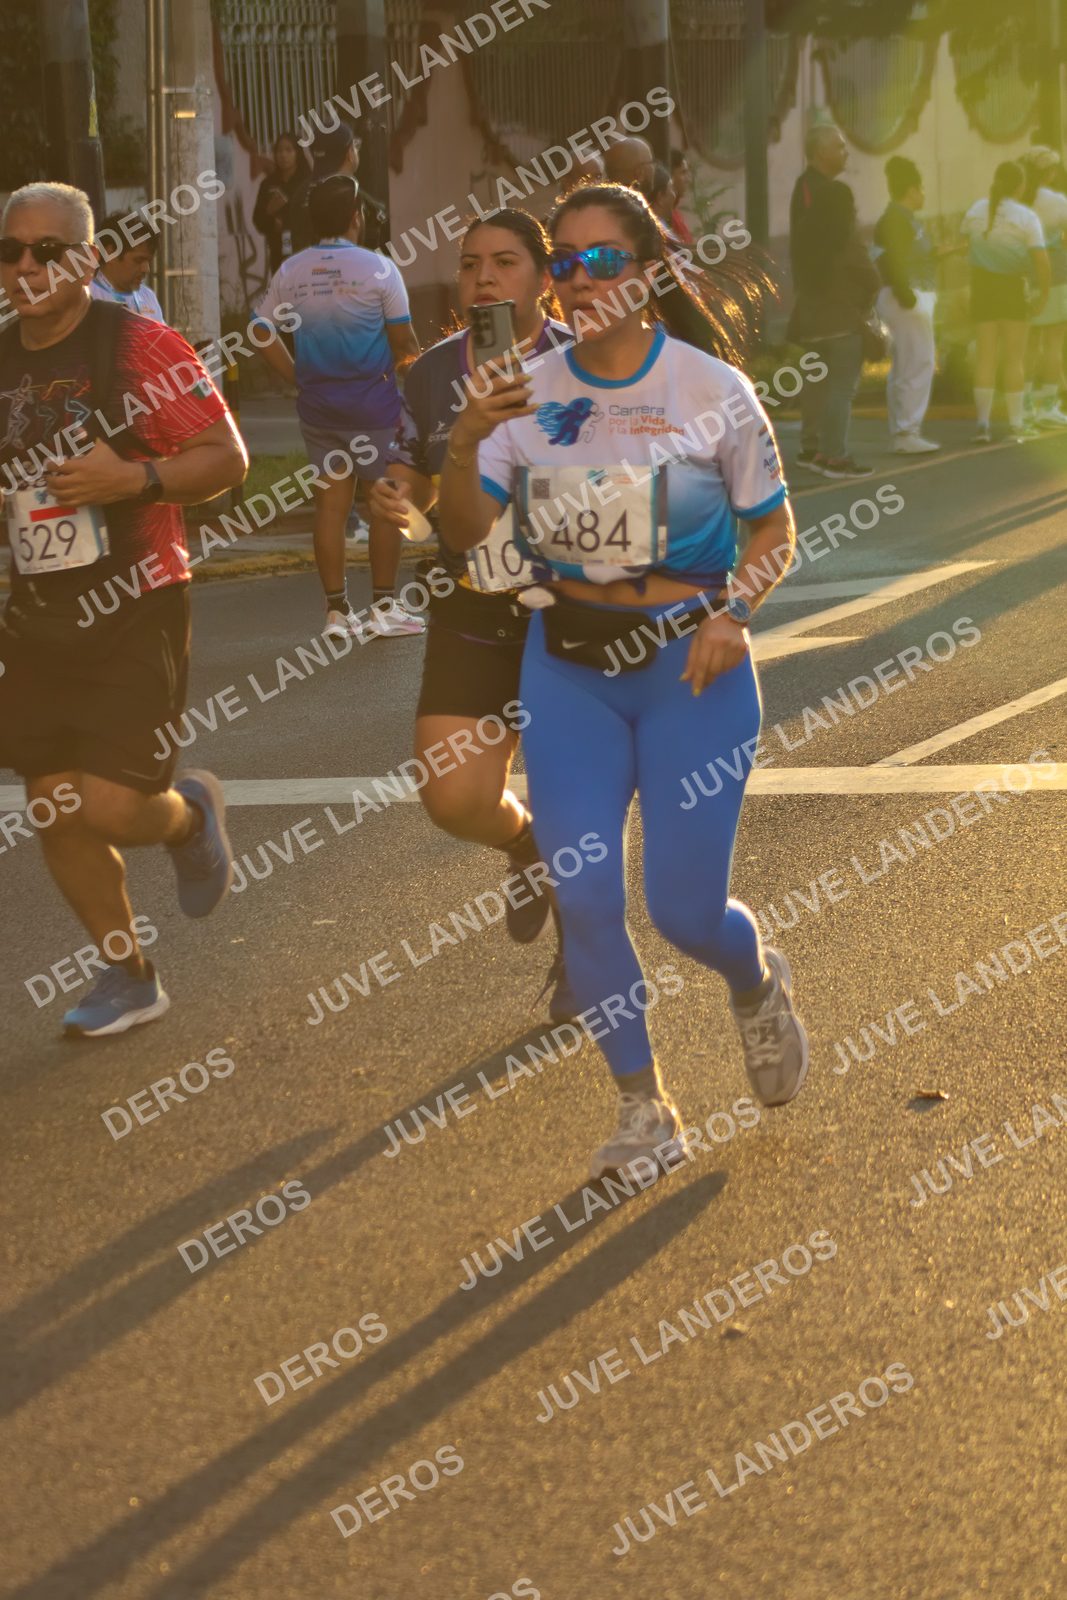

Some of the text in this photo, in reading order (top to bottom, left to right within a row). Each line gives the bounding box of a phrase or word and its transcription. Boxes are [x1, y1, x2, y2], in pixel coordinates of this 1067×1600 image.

[608, 405, 665, 416] Carrera
[640, 415, 665, 424] Vida
[18, 520, 77, 563] 529
[551, 509, 632, 553] 484
